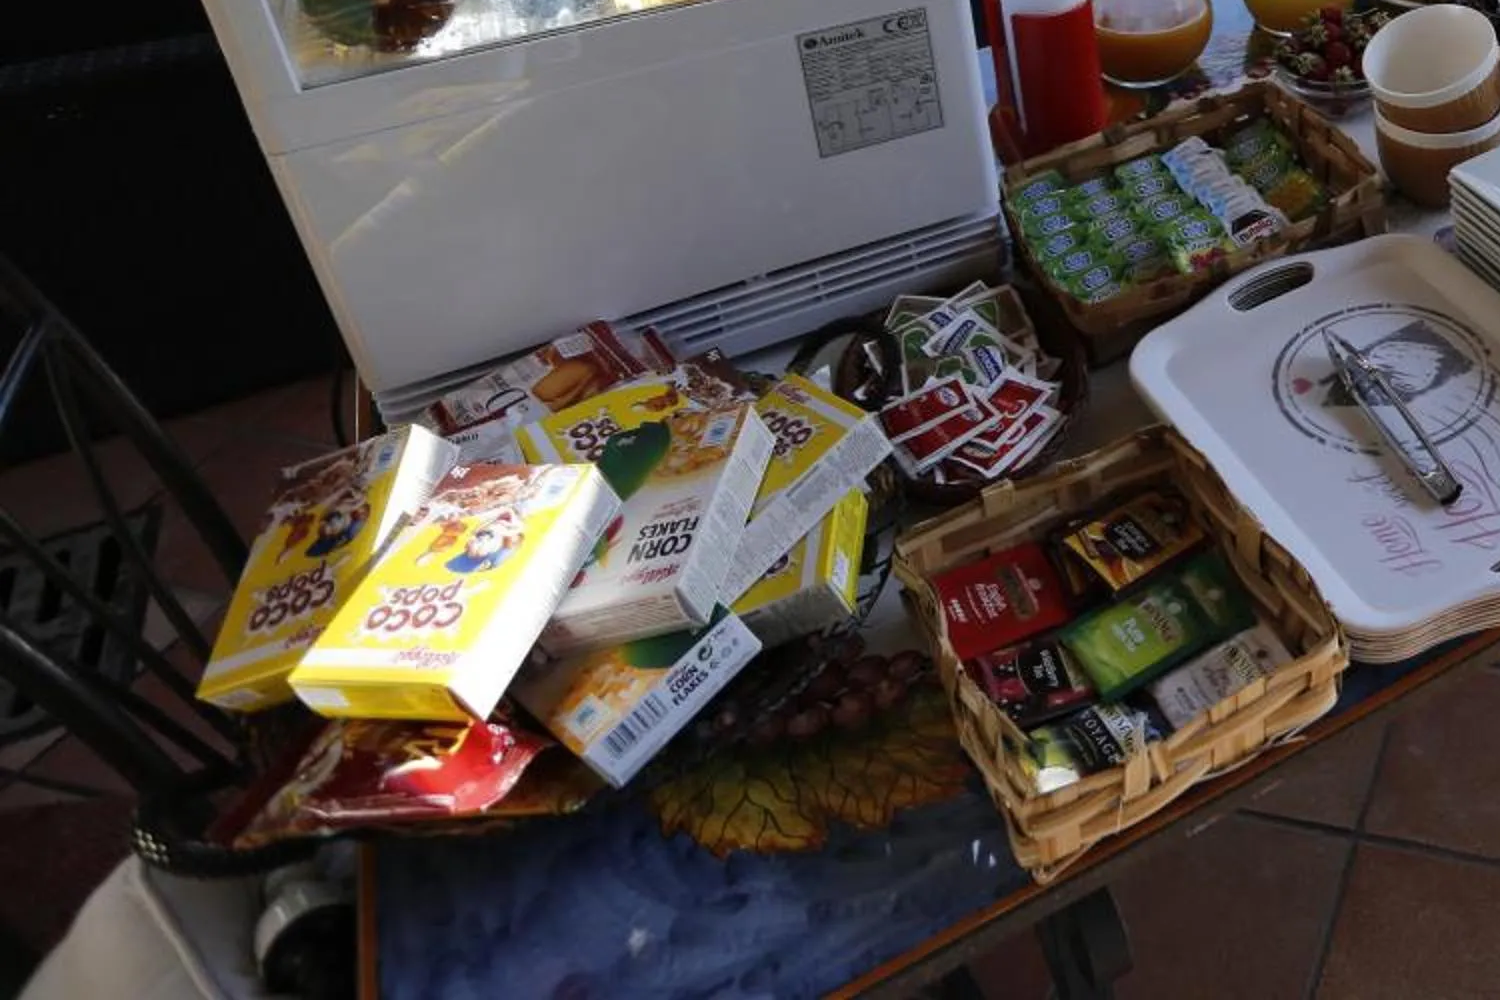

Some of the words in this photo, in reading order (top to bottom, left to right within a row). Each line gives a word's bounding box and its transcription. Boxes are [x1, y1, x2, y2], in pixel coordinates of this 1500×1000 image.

[637, 515, 700, 542] FLAKES
[626, 533, 692, 564] CORN
[669, 664, 699, 694] CORN
[671, 669, 709, 706] FLAKES
